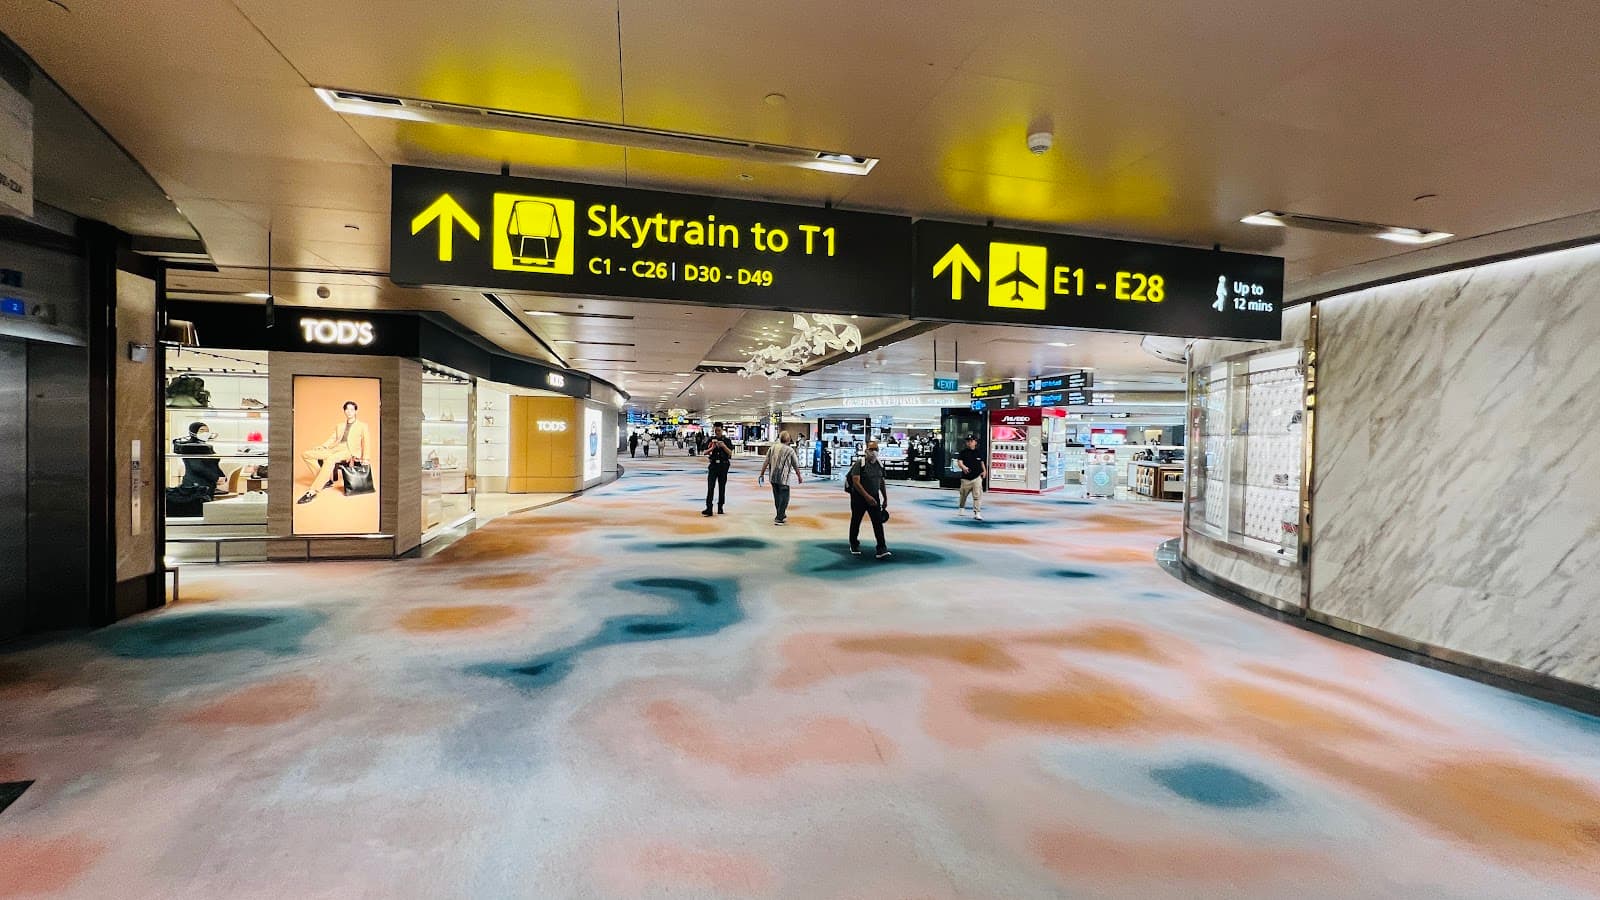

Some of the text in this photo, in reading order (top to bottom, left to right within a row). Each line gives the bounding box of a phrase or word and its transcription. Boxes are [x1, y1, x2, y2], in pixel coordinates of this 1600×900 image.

[587, 204, 835, 257] Skytrain to T1
[588, 257, 611, 275] C1
[631, 260, 667, 279] C26
[684, 264, 721, 283] D30
[737, 268, 774, 287] D49
[1053, 266, 1084, 296] E1
[1115, 271, 1165, 303] E28
[1233, 281, 1264, 296] Up to
[1233, 297, 1273, 313] 12 mins
[300, 317, 374, 346] TOD'S
[940, 380, 955, 390] EXIT
